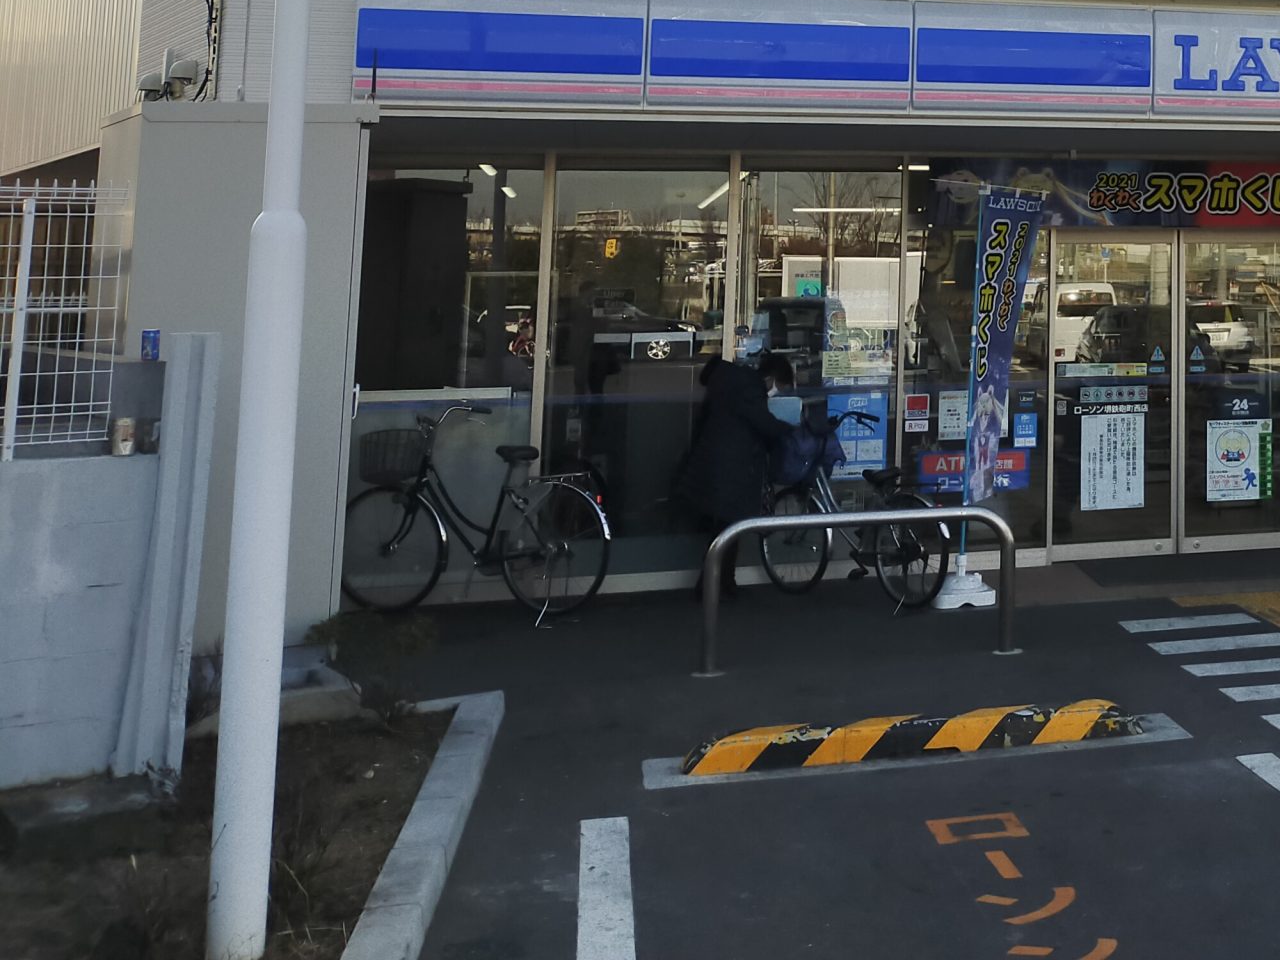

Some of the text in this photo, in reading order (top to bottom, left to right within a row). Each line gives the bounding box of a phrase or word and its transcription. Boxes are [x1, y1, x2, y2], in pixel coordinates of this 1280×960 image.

[1097, 173, 1139, 189] 2021
[1088, 189, 1142, 211] わくわく
[977, 219, 1011, 381] スマホくじ
[1232, 399, 1248, 410] 24
